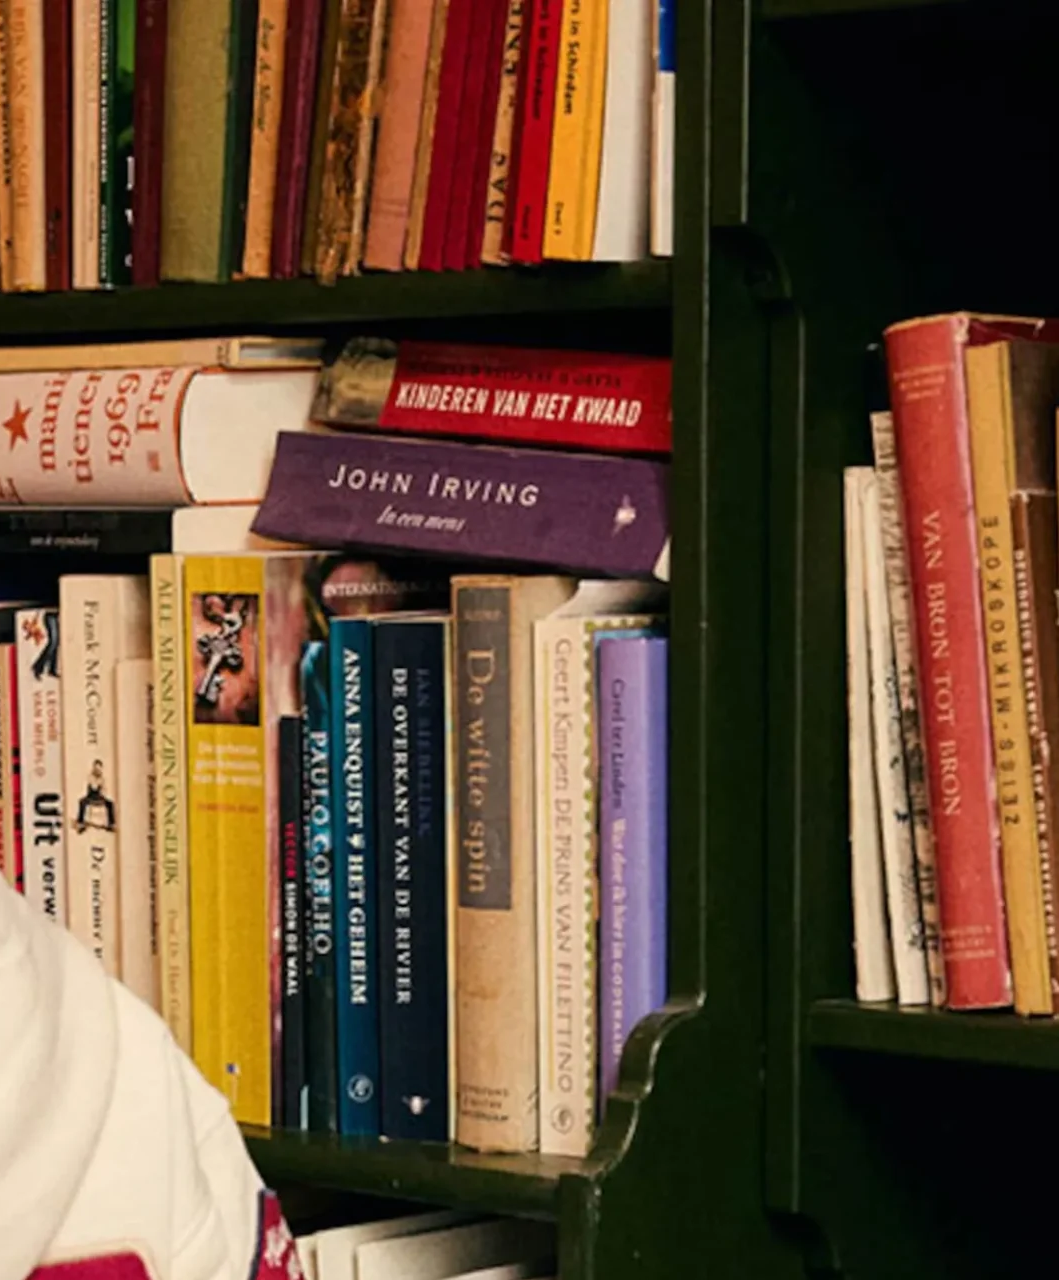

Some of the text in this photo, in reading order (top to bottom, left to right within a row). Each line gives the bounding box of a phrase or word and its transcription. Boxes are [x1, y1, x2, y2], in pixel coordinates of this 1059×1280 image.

[561, 41, 583, 116] Schiedam
[567, 20, 582, 36] in
[102, 370, 142, 466] 1969
[134, 368, 176, 434] Fra
[395, 381, 643, 428] KINDEREN VAN HET KWAAD
[328, 463, 541, 507] JOHN IRVING
[83, 599, 104, 746] Frank McCourt
[920, 509, 963, 817] VAN BRON TOT BRON
[156, 577, 180, 886] ALLE MENSEN ZIJN ONGELIJK
[308, 730, 331, 826] PAULO
[343, 647, 364, 828] ANNA ENQUIST
[463, 648, 498, 895] De witte spin
[609, 678, 628, 810] Carel ter Linden
[33, 792, 62, 919] Uit verw
[91, 845, 106, 872] De
[392, 667, 412, 1005] DE OVERKANT VAN DE RIVIER
[551, 637, 574, 1095] Geert Kimpen DE PRINS VAN FILETTINO
[284, 882, 298, 931] SIMON
[285, 933, 298, 953] DE
[311, 831, 332, 956] COELHO
[347, 854, 368, 1005] HET GEHEIM
[285, 956, 299, 997] WAAL
